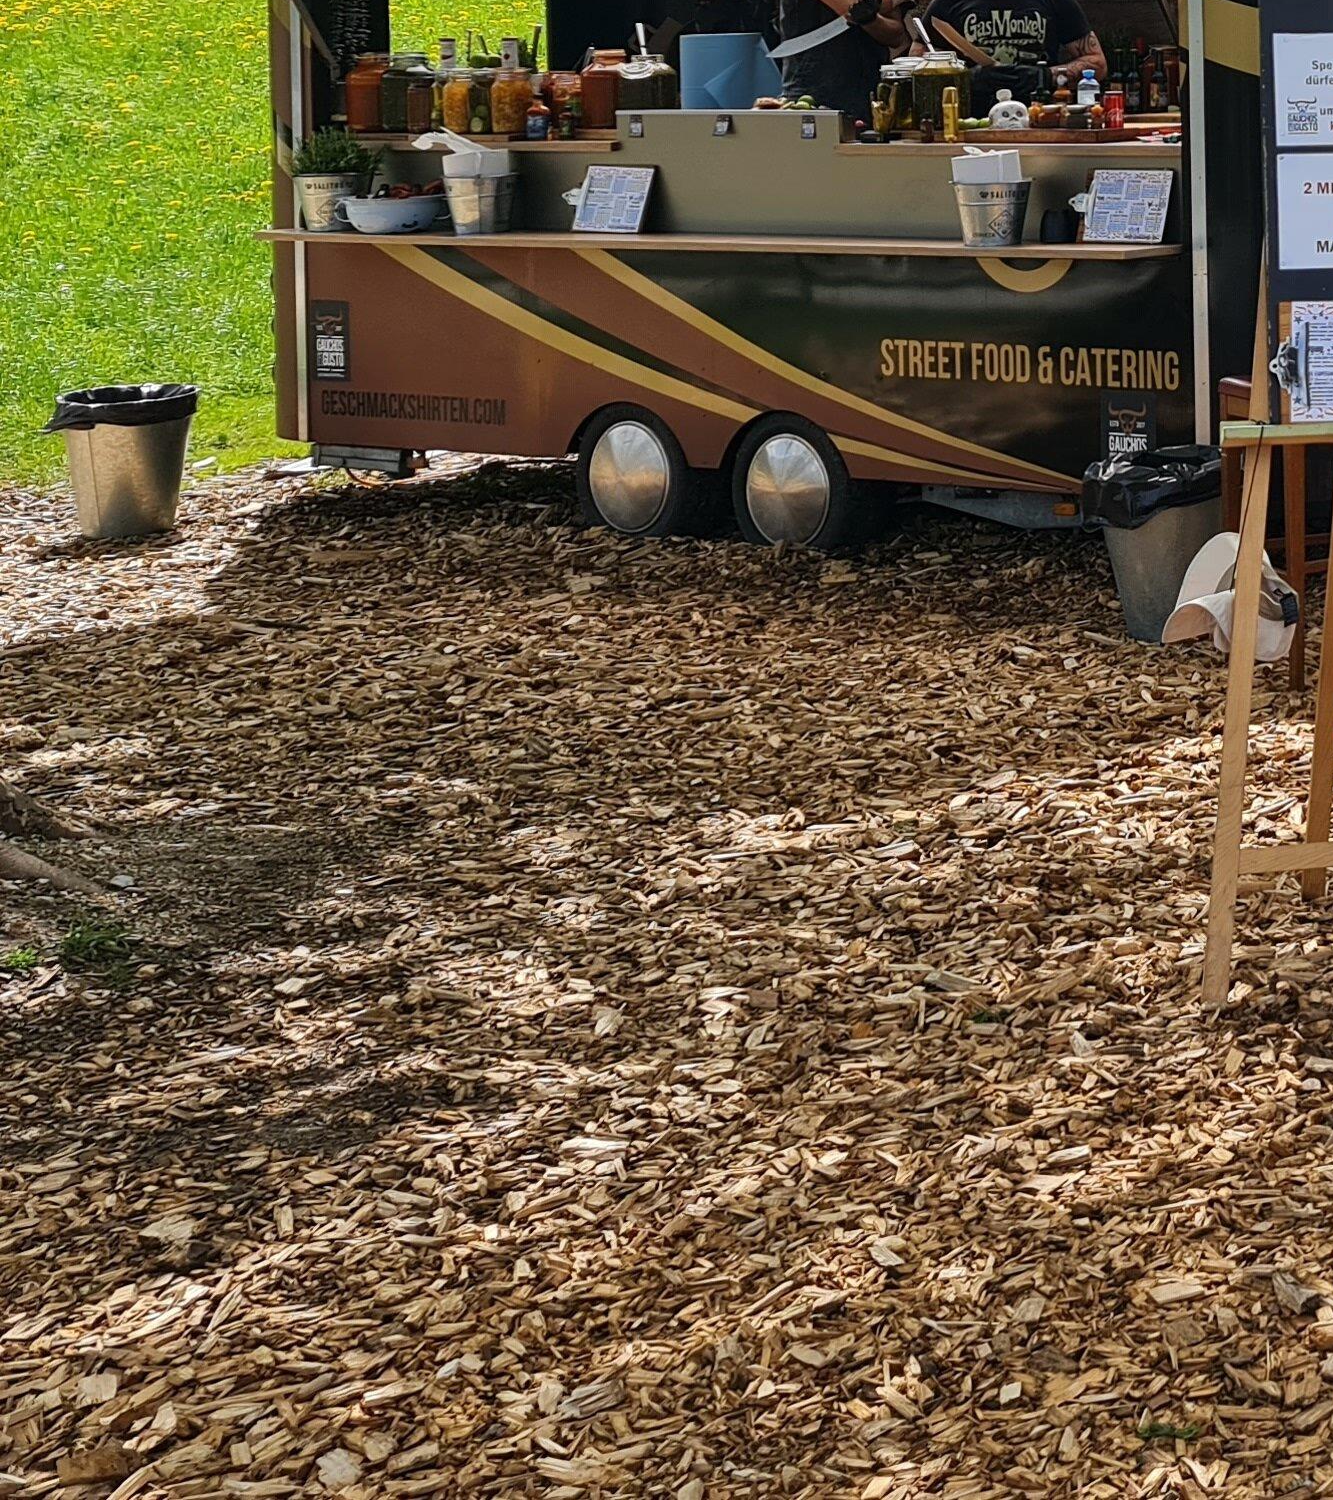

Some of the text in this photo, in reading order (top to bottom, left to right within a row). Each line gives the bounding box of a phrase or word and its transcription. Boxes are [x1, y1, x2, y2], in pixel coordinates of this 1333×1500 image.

[1303, 182, 1312, 194] 2
[323, 352, 344, 367] GUSTO
[880, 338, 1180, 391] STREET FOOD & CATERING
[320, 389, 507, 426] GESCHMACKSHIRTEN.COM
[1108, 435, 1148, 452] GAUCHOS
